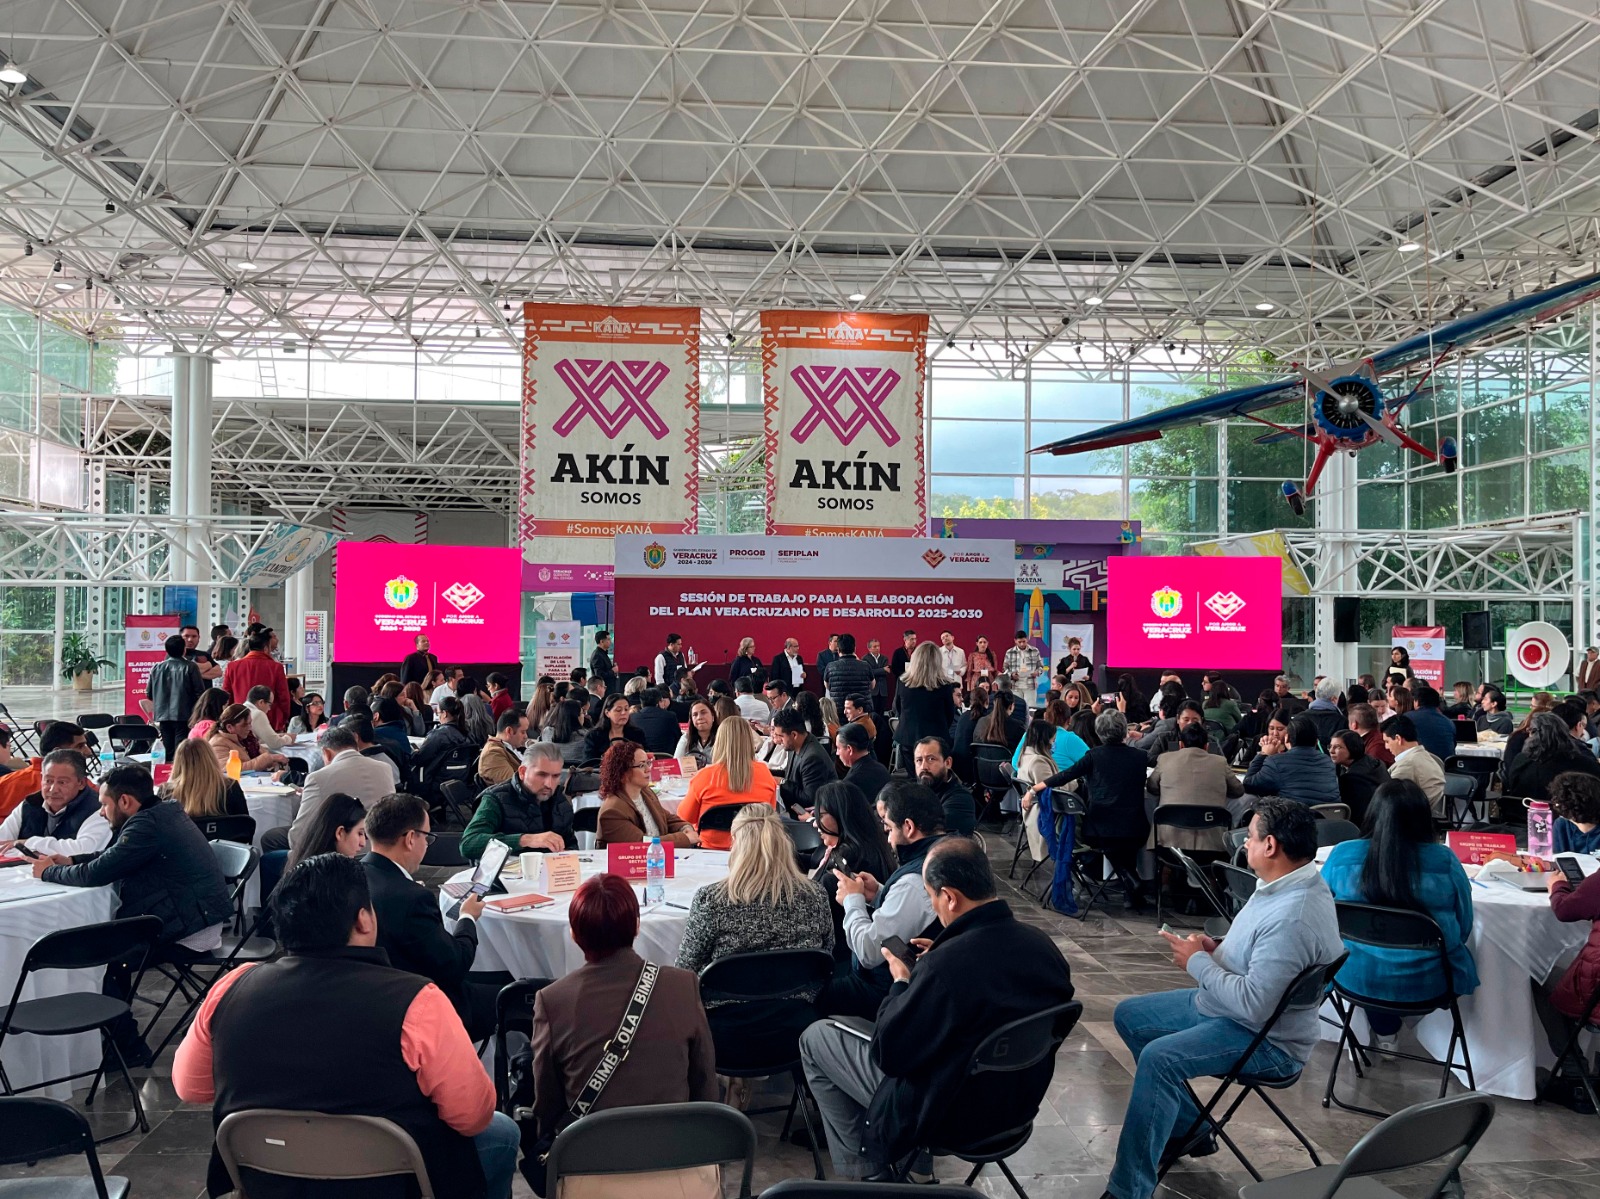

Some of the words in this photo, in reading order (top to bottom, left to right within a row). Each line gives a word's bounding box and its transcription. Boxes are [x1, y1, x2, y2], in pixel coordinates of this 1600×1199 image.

[550, 443, 669, 485] AKÍN
[789, 450, 901, 492] AKÍN
[580, 491, 642, 505] SOMOS
[817, 497, 875, 511] SOMOS
[566, 522, 653, 535] #SomosKANÁ
[673, 552, 718, 560] VERACRUZ
[777, 549, 819, 557] SEFIPLAN
[680, 591, 726, 603] SESIÓN
[729, 593, 745, 603] DE
[748, 593, 806, 604] TRABAJO
[809, 594, 843, 604] PARA
[846, 595, 862, 604] LA
[866, 594, 954, 605] ELABORACIÓN
[649, 606, 674, 616] DEL
[677, 606, 711, 616] PLAN
[715, 607, 809, 617] VERACRUZANO
[813, 608, 830, 617] DE
[832, 608, 915, 618] DESARROLLO
[917, 608, 983, 619] 2025-2030
[374, 618, 427, 626] VERACRUZ
[1142, 626, 1192, 634] VERACRUZ
[1204, 811, 1214, 822] G
[206, 822, 217, 833] G
[617, 1013, 640, 1050] OLA
